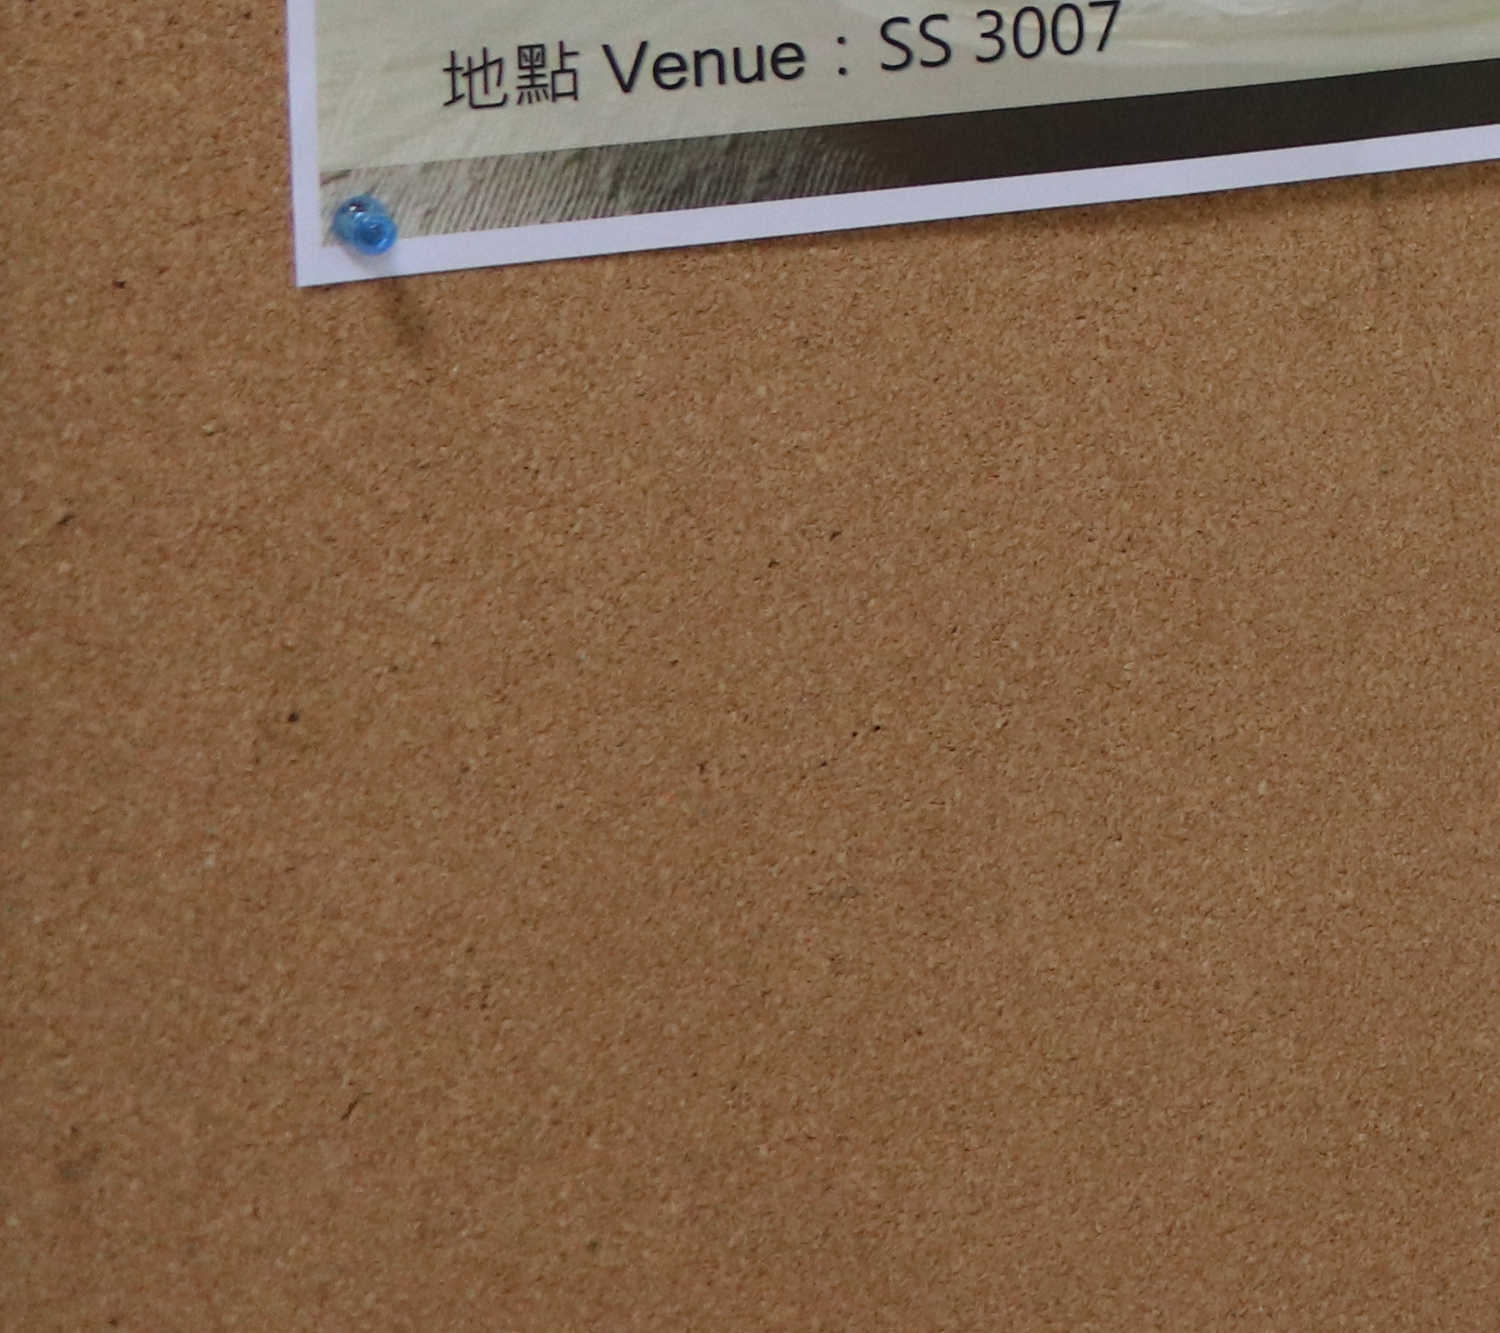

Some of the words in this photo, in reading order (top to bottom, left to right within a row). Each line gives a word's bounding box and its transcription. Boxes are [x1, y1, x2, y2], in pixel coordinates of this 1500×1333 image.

[442, 40, 580, 110] 地點
[879, 13, 952, 72] SS
[975, 0, 1121, 64] 3007
